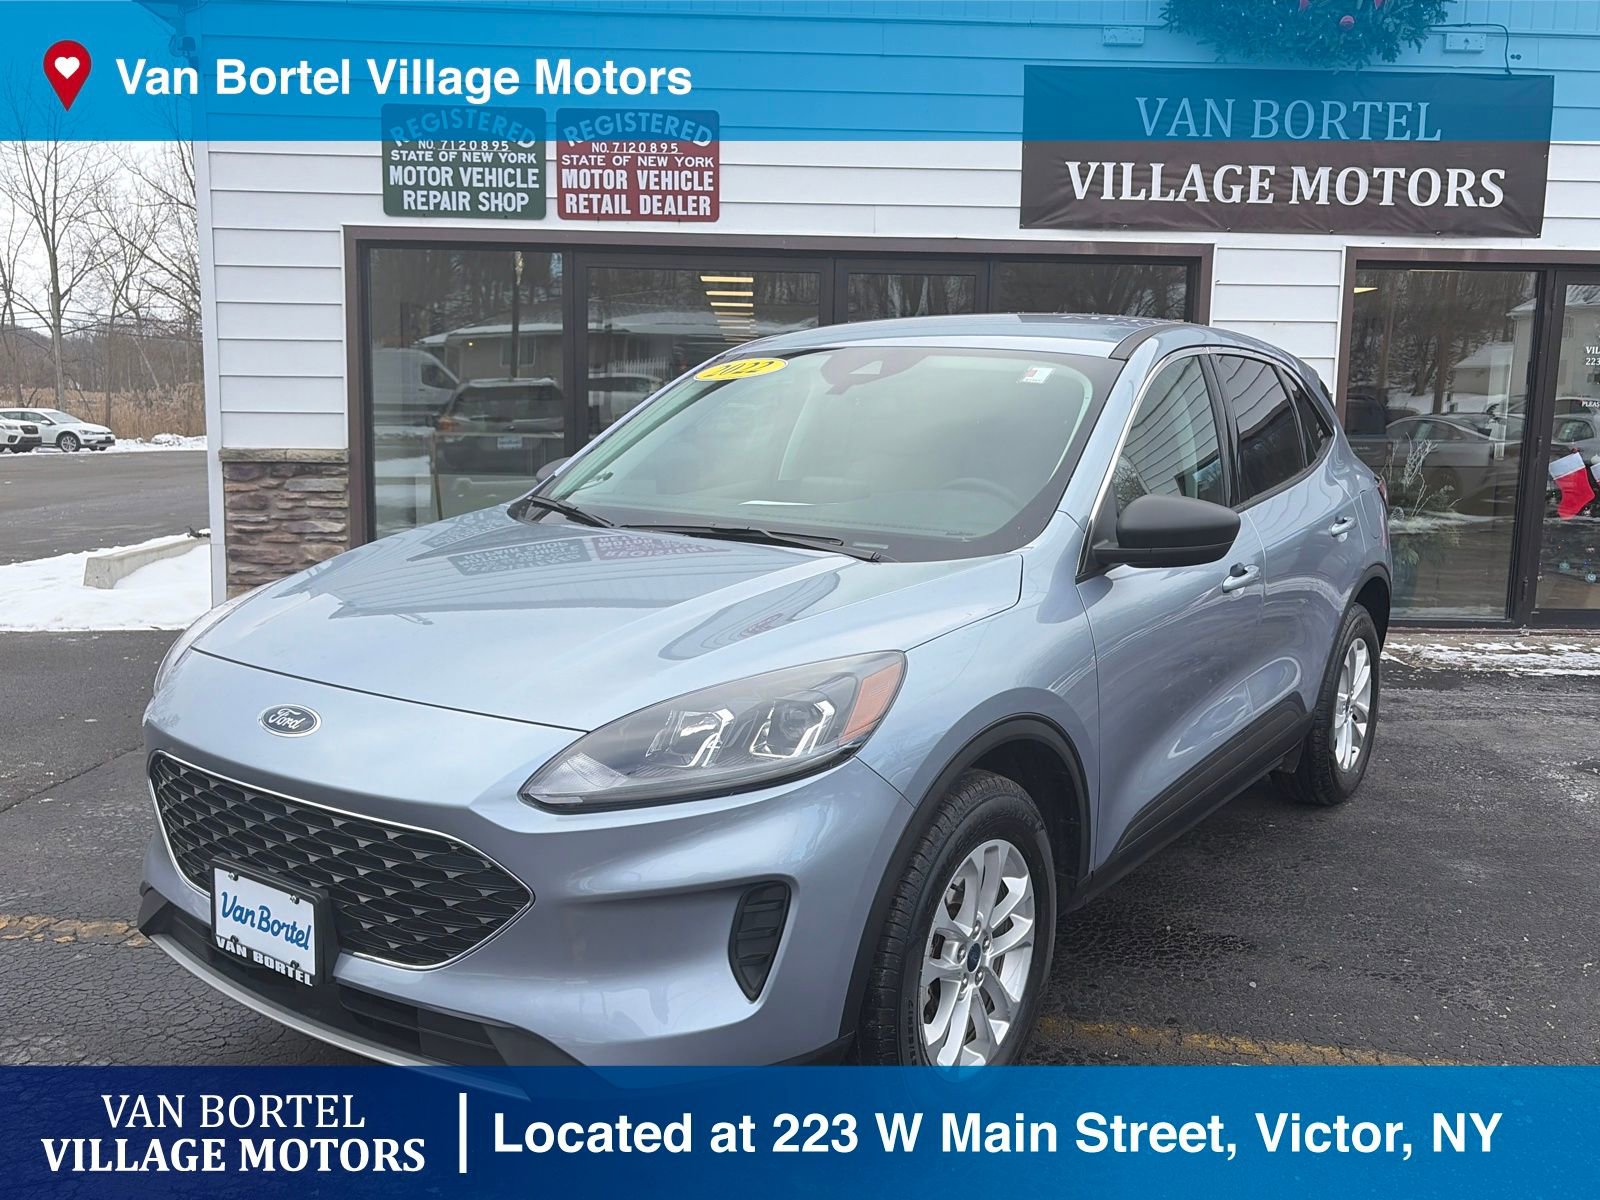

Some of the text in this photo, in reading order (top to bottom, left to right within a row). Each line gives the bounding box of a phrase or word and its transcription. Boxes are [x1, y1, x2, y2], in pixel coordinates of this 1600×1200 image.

[390, 108, 536, 148] REGISTERED
[563, 112, 713, 147] REGISTERED
[1136, 97, 1442, 142] VAN BORTEL
[390, 150, 537, 164] STATE OF NEW YORK
[441, 140, 510, 151] 7120895
[591, 142, 679, 154] NO. 7120895
[561, 154, 714, 168] STATE OF NEW YORK
[389, 165, 540, 189] MOTOR VEHICLE
[561, 168, 714, 191] MOTOR VEHICLE
[1065, 161, 1505, 208] VILLAGE MOTORS
[403, 189, 530, 213] REPAIR SHOP
[565, 193, 711, 216] RETAIL DEALER
[703, 360, 775, 378] 2022
[269, 708, 306, 730] Ford
[215, 935, 313, 987] VAN BORTEL
